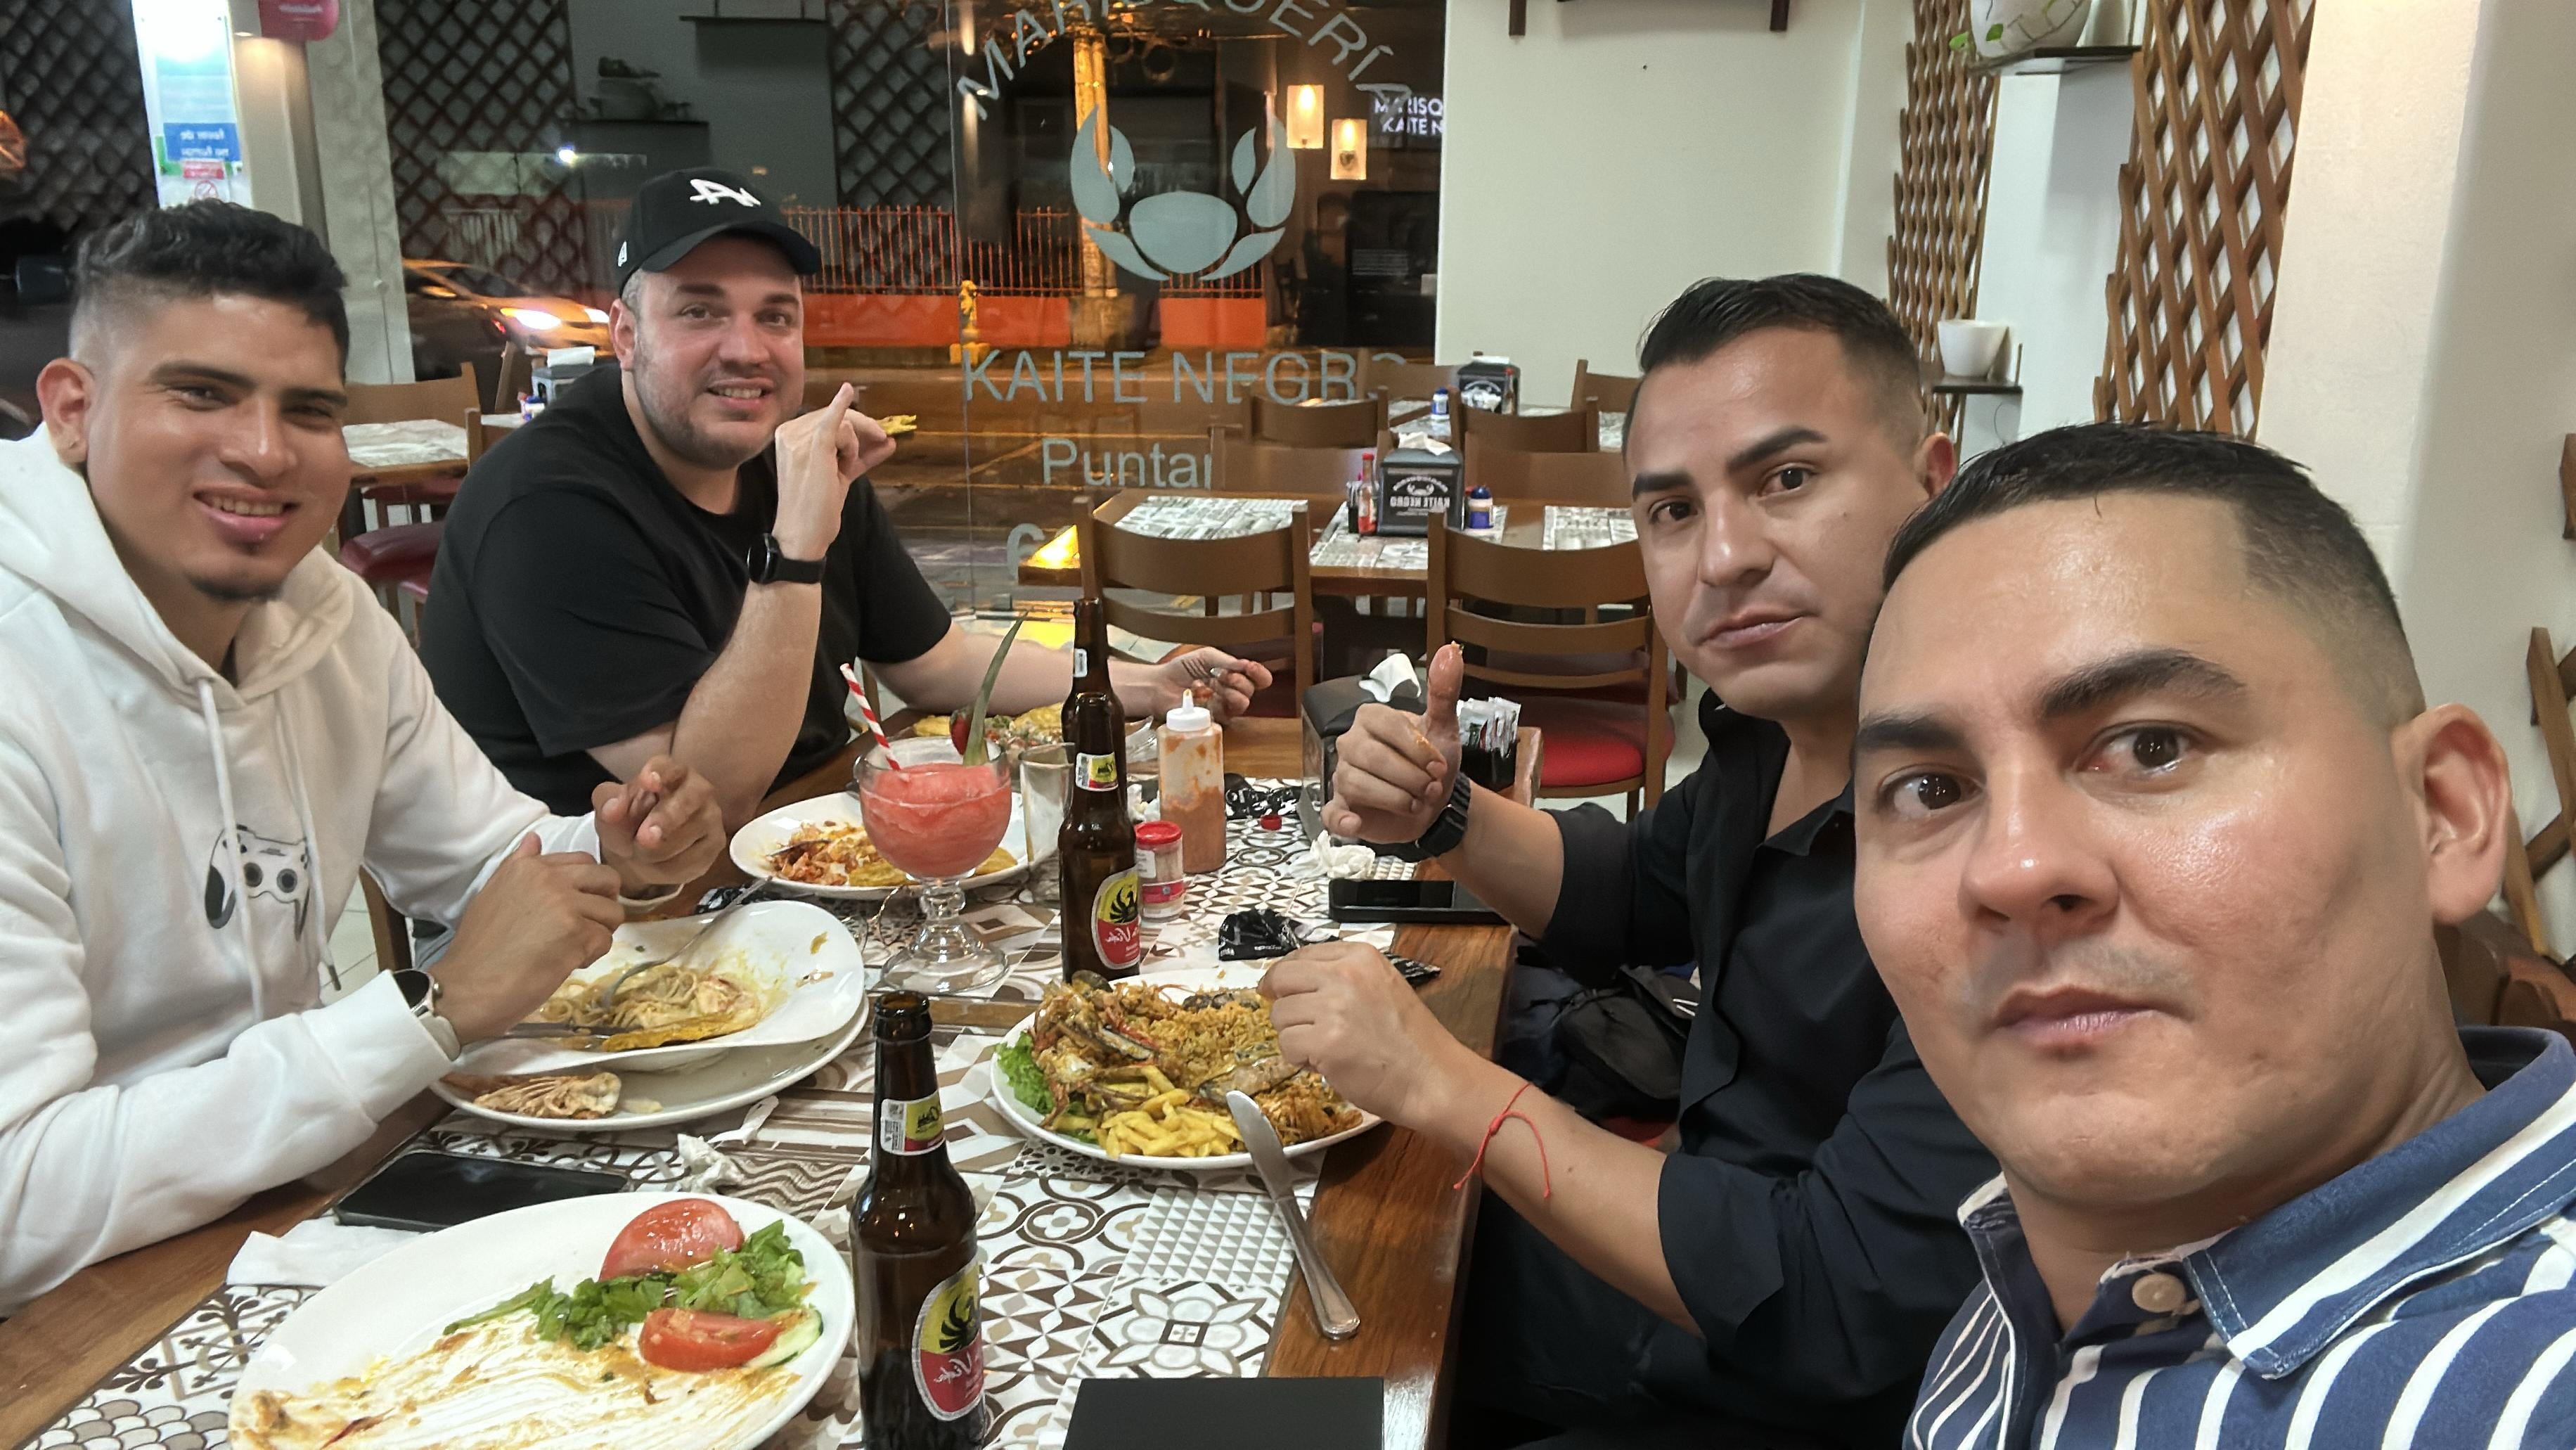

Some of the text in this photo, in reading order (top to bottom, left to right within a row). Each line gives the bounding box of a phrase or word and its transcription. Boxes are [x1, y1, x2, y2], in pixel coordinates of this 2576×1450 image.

[957, 0, 1412, 124] MARERÍA
[961, 349, 1407, 406] KAITE NEGR
